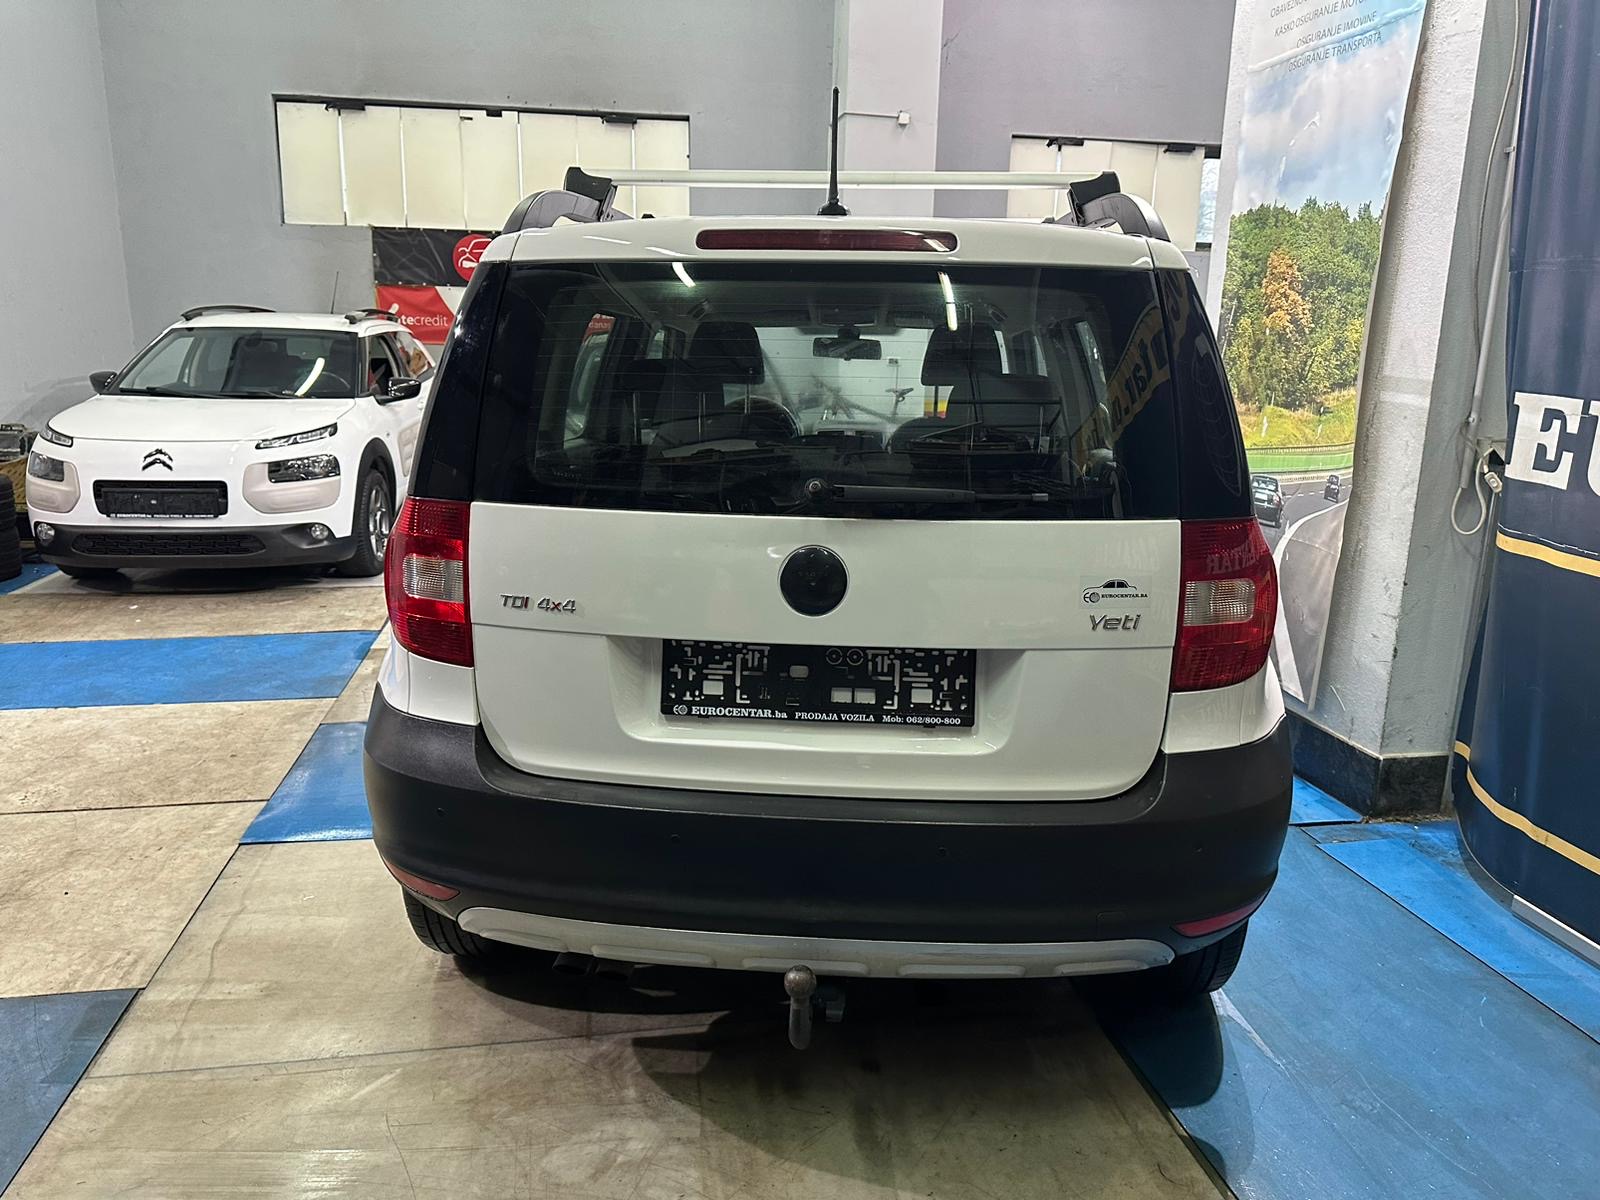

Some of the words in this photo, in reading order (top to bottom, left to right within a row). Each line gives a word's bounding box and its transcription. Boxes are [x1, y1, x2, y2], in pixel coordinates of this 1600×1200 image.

[1274, 20, 1295, 37] KASKO
[1296, 2, 1339, 28] OSIGURANJE
[1296, 24, 1342, 48] OSIGURANJE
[1343, 10, 1377, 32] IMOVINE
[1288, 48, 1330, 72] OSIGURANJE
[1332, 31, 1382, 57] TRANSPORTA
[1504, 391, 1600, 497] E
[500, 594, 530, 609] TDI
[537, 597, 577, 613] 4x4
[1089, 614, 1142, 631] Yeti
[691, 706, 788, 719] EUROCENTAR.ba
[795, 711, 839, 721] PRODAJA
[841, 713, 875, 722] VOZILA
[882, 715, 904, 723] Mob:
[906, 716, 961, 725] 062/800-800
